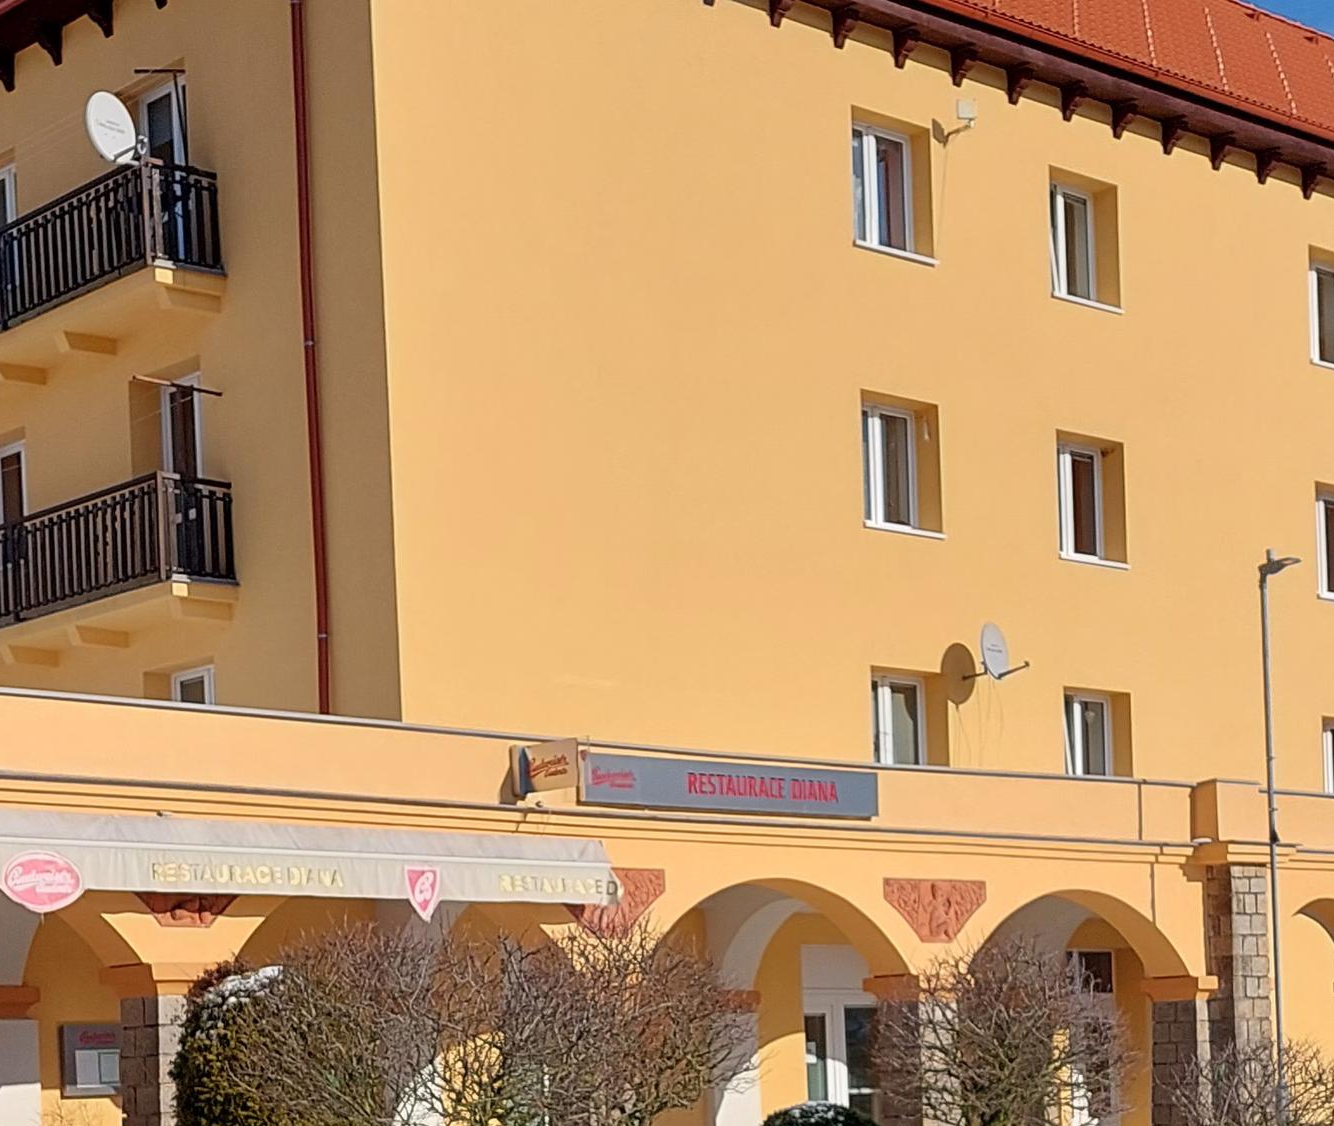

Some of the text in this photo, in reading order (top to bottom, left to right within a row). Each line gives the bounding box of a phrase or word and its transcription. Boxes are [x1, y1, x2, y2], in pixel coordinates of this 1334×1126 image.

[687, 772, 839, 802] RESTAURACE DIANA
[151, 863, 343, 888] RESTAURACE DIANA
